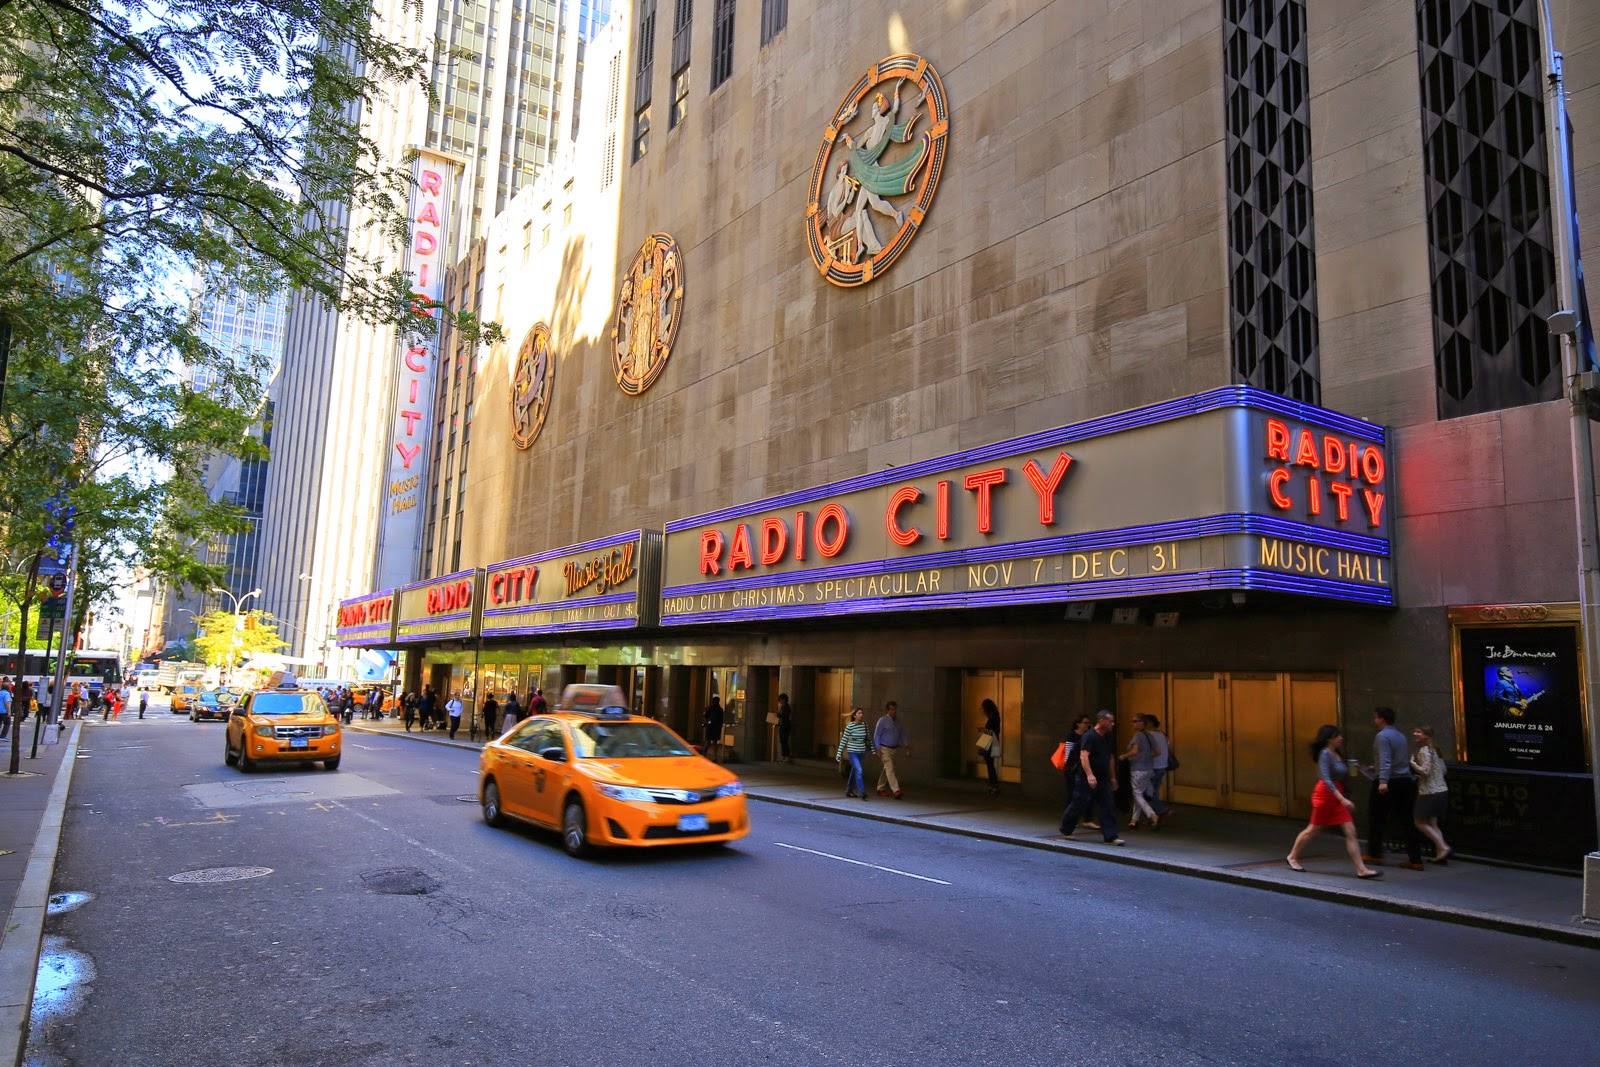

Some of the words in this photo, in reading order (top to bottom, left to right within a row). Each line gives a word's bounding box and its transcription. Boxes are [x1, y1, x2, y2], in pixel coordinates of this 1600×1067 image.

[395, 346, 427, 468] CITY
[1267, 418, 1384, 485] RADIO
[700, 503, 849, 576] RADIO
[886, 452, 1075, 547] CITY
[1270, 467, 1384, 528] CITY
[490, 566, 537, 604] CITY
[563, 557, 601, 597] Music
[595, 540, 634, 596] Hall
[664, 597, 694, 614] RADIO
[701, 592, 725, 611] CITY
[732, 584, 805, 607] CHRISTMAS
[815, 570, 941, 601] SPECTACULAR
[968, 562, 1014, 588] NOV
[1032, 558, 1044, 582] 7
[1072, 549, 1126, 580] DEC
[1151, 543, 1177, 572] 31
[1261, 537, 1329, 576] MUSIC
[1337, 551, 1387, 584] HALL
[368, 597, 391, 622] CITY
[426, 580, 471, 614] RADIO
[1494, 722, 1526, 730] JANUARY
